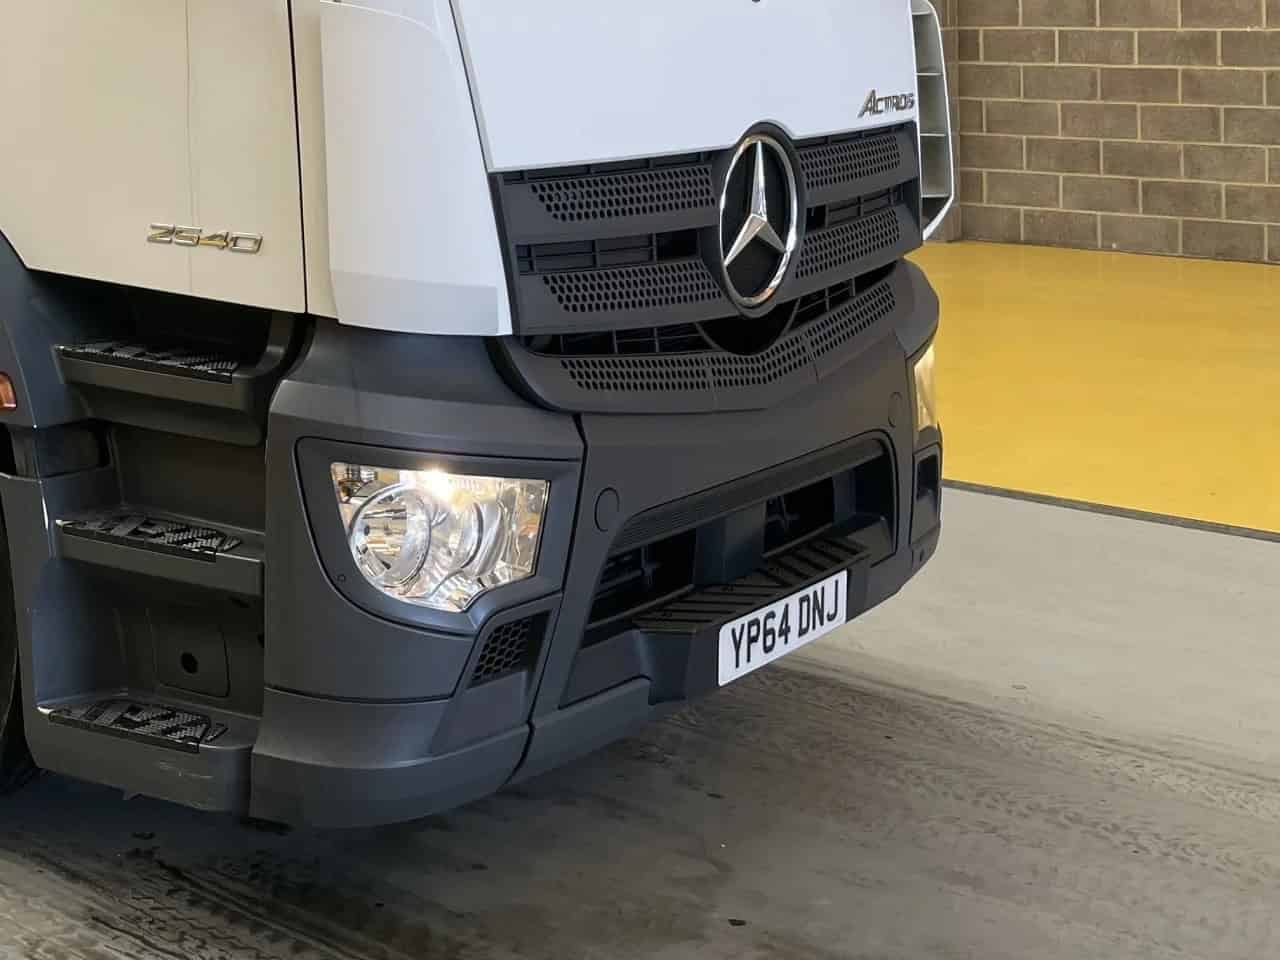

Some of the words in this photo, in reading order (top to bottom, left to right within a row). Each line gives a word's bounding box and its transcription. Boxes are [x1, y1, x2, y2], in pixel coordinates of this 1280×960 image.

[147, 223, 264, 255] 2540
[731, 602, 791, 669] YP64
[798, 579, 839, 638] DNJ
